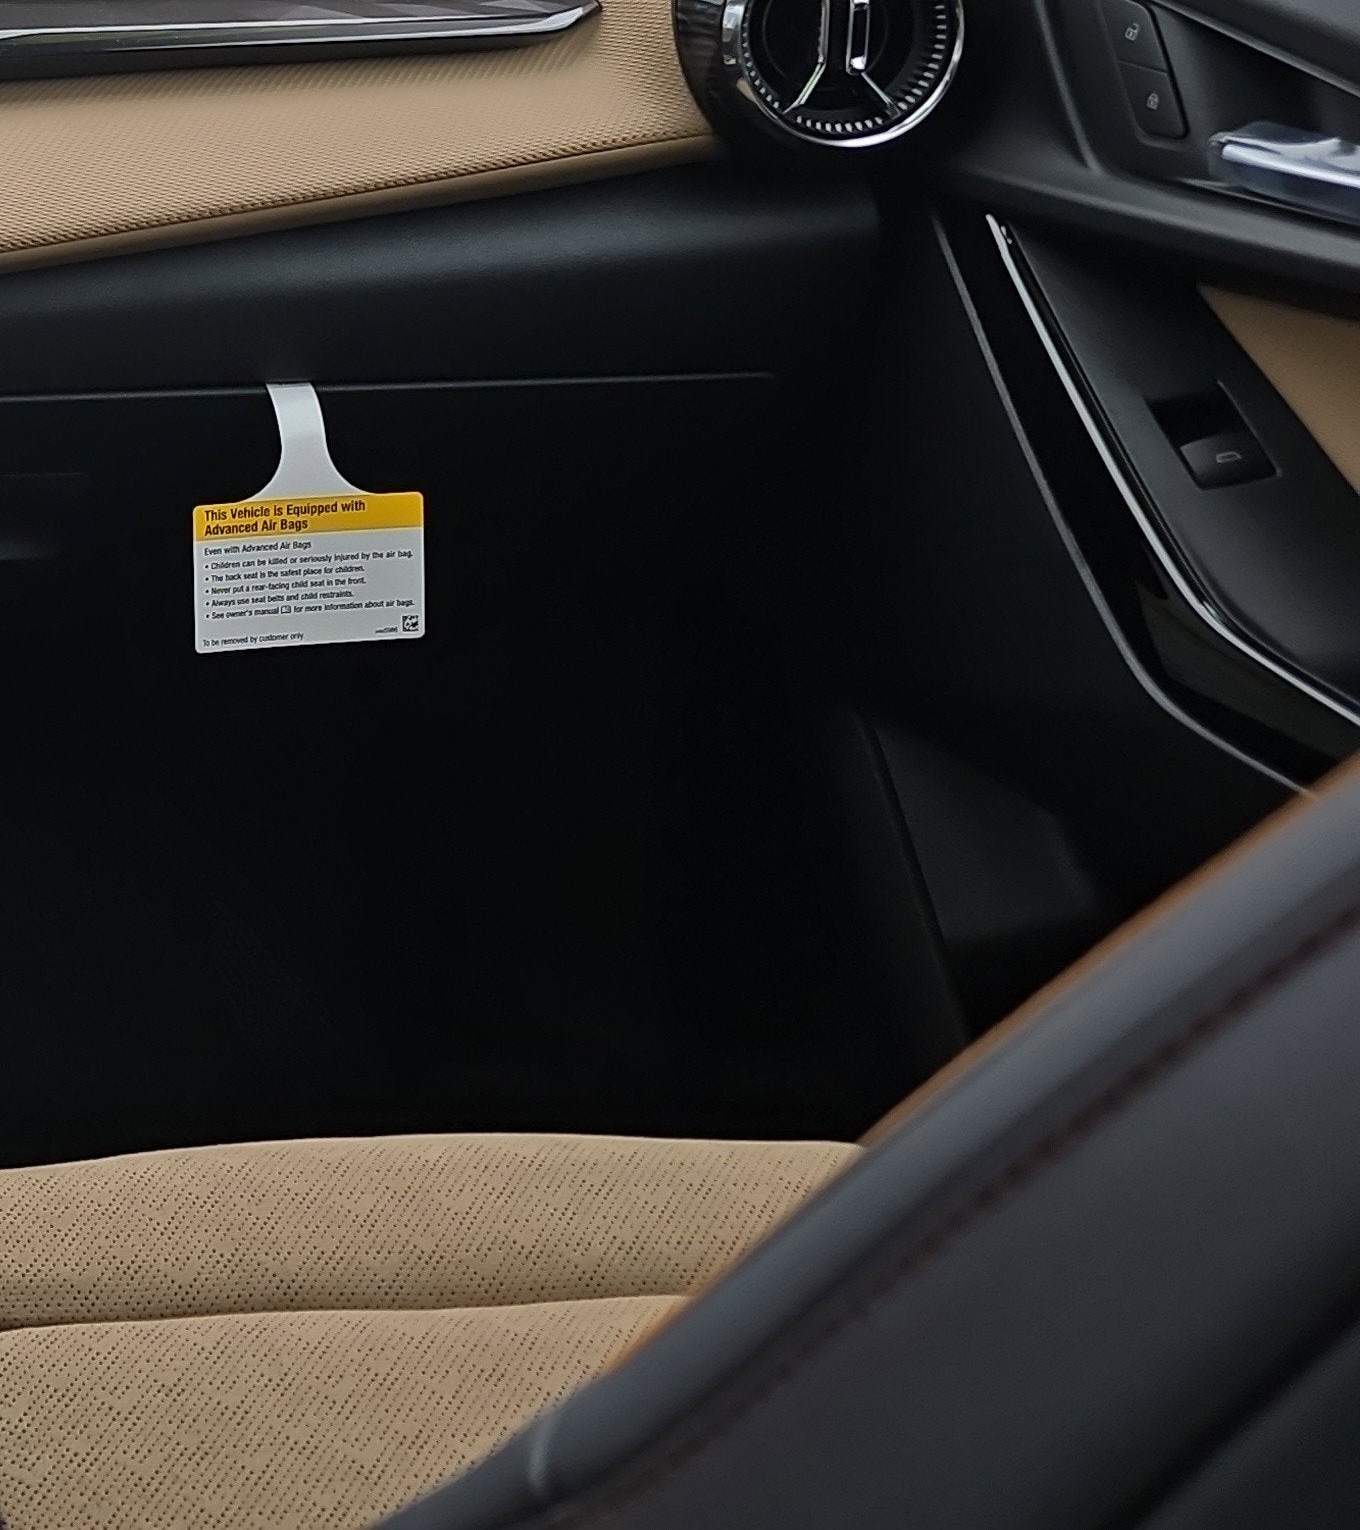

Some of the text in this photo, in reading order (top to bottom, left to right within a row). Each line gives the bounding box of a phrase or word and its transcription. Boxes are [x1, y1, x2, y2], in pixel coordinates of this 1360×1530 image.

[204, 509, 227, 522] This
[230, 506, 270, 520] Vehicle
[286, 501, 338, 518] Equipped
[341, 500, 366, 512] with
[204, 518, 309, 537] Advanced Air Bags
[204, 541, 312, 557] Even with Advanced Air Bags
[211, 548, 414, 571] Children can be killed or seriously injured by the air bag.
[211, 564, 366, 583] The back seat is the safest place for children.
[211, 586, 231, 596] Never
[232, 585, 244, 595] put
[251, 581, 290, 593] rear-facing
[291, 579, 308, 589] child
[309, 578, 325, 587] seat
[326, 578, 333, 586] in
[334, 577, 346, 586] the
[347, 576, 367, 585] front.
[211, 589, 355, 609] Always use seat belts and child restraints.
[211, 611, 225, 620] See
[254, 606, 279, 617] manual
[293, 604, 303, 613] for
[304, 604, 323, 612] more
[324, 600, 363, 612] information
[364, 599, 384, 609] about
[385, 599, 395, 607] air
[203, 632, 304, 648] To be removed by customer only
